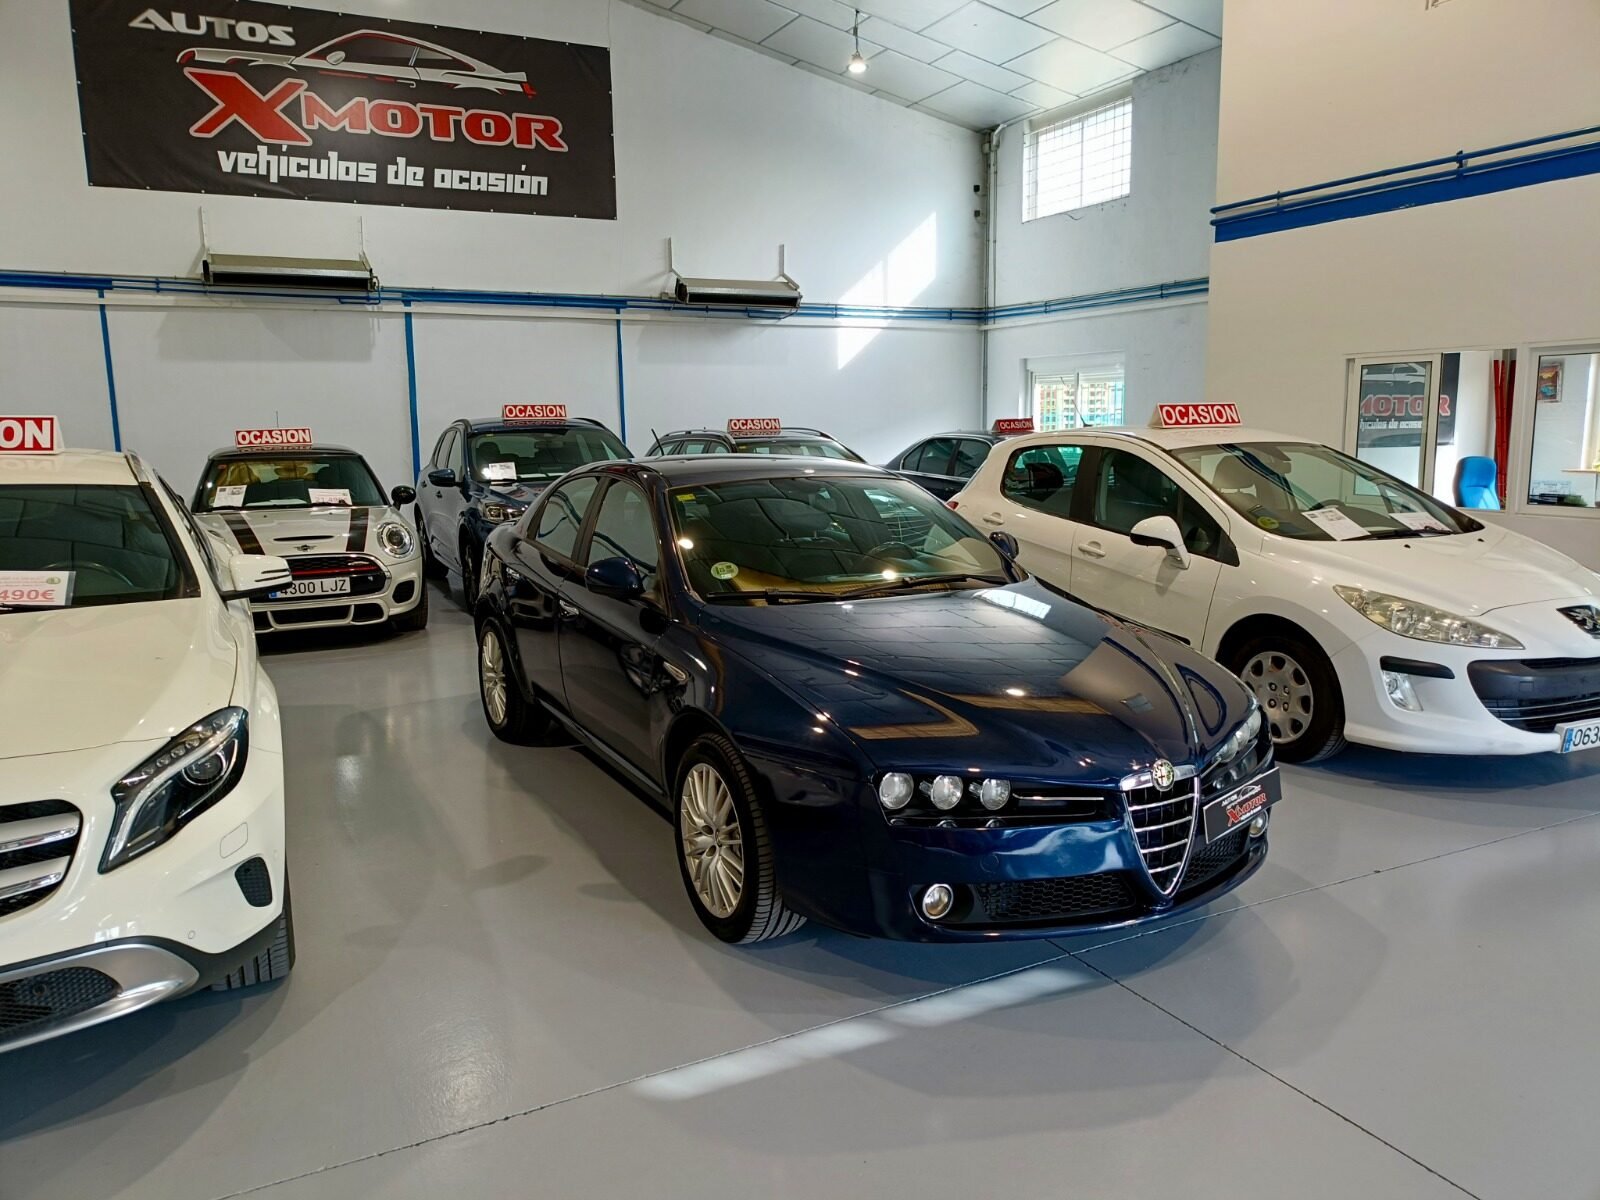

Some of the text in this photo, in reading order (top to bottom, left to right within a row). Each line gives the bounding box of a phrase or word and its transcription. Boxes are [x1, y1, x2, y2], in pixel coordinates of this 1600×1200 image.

[128, 8, 296, 47] AUTOS
[184, 66, 569, 152] XMOTOR
[217, 144, 548, 196] vehículos de ocasión
[505, 405, 566, 418] OCASION
[1162, 405, 1239, 424] OCASION
[731, 419, 780, 430] OCASION
[1000, 420, 1033, 430] OCASION
[237, 430, 311, 445] OCASION
[320, 579, 347, 593] LJZ
[1573, 726, 1600, 747] 063
